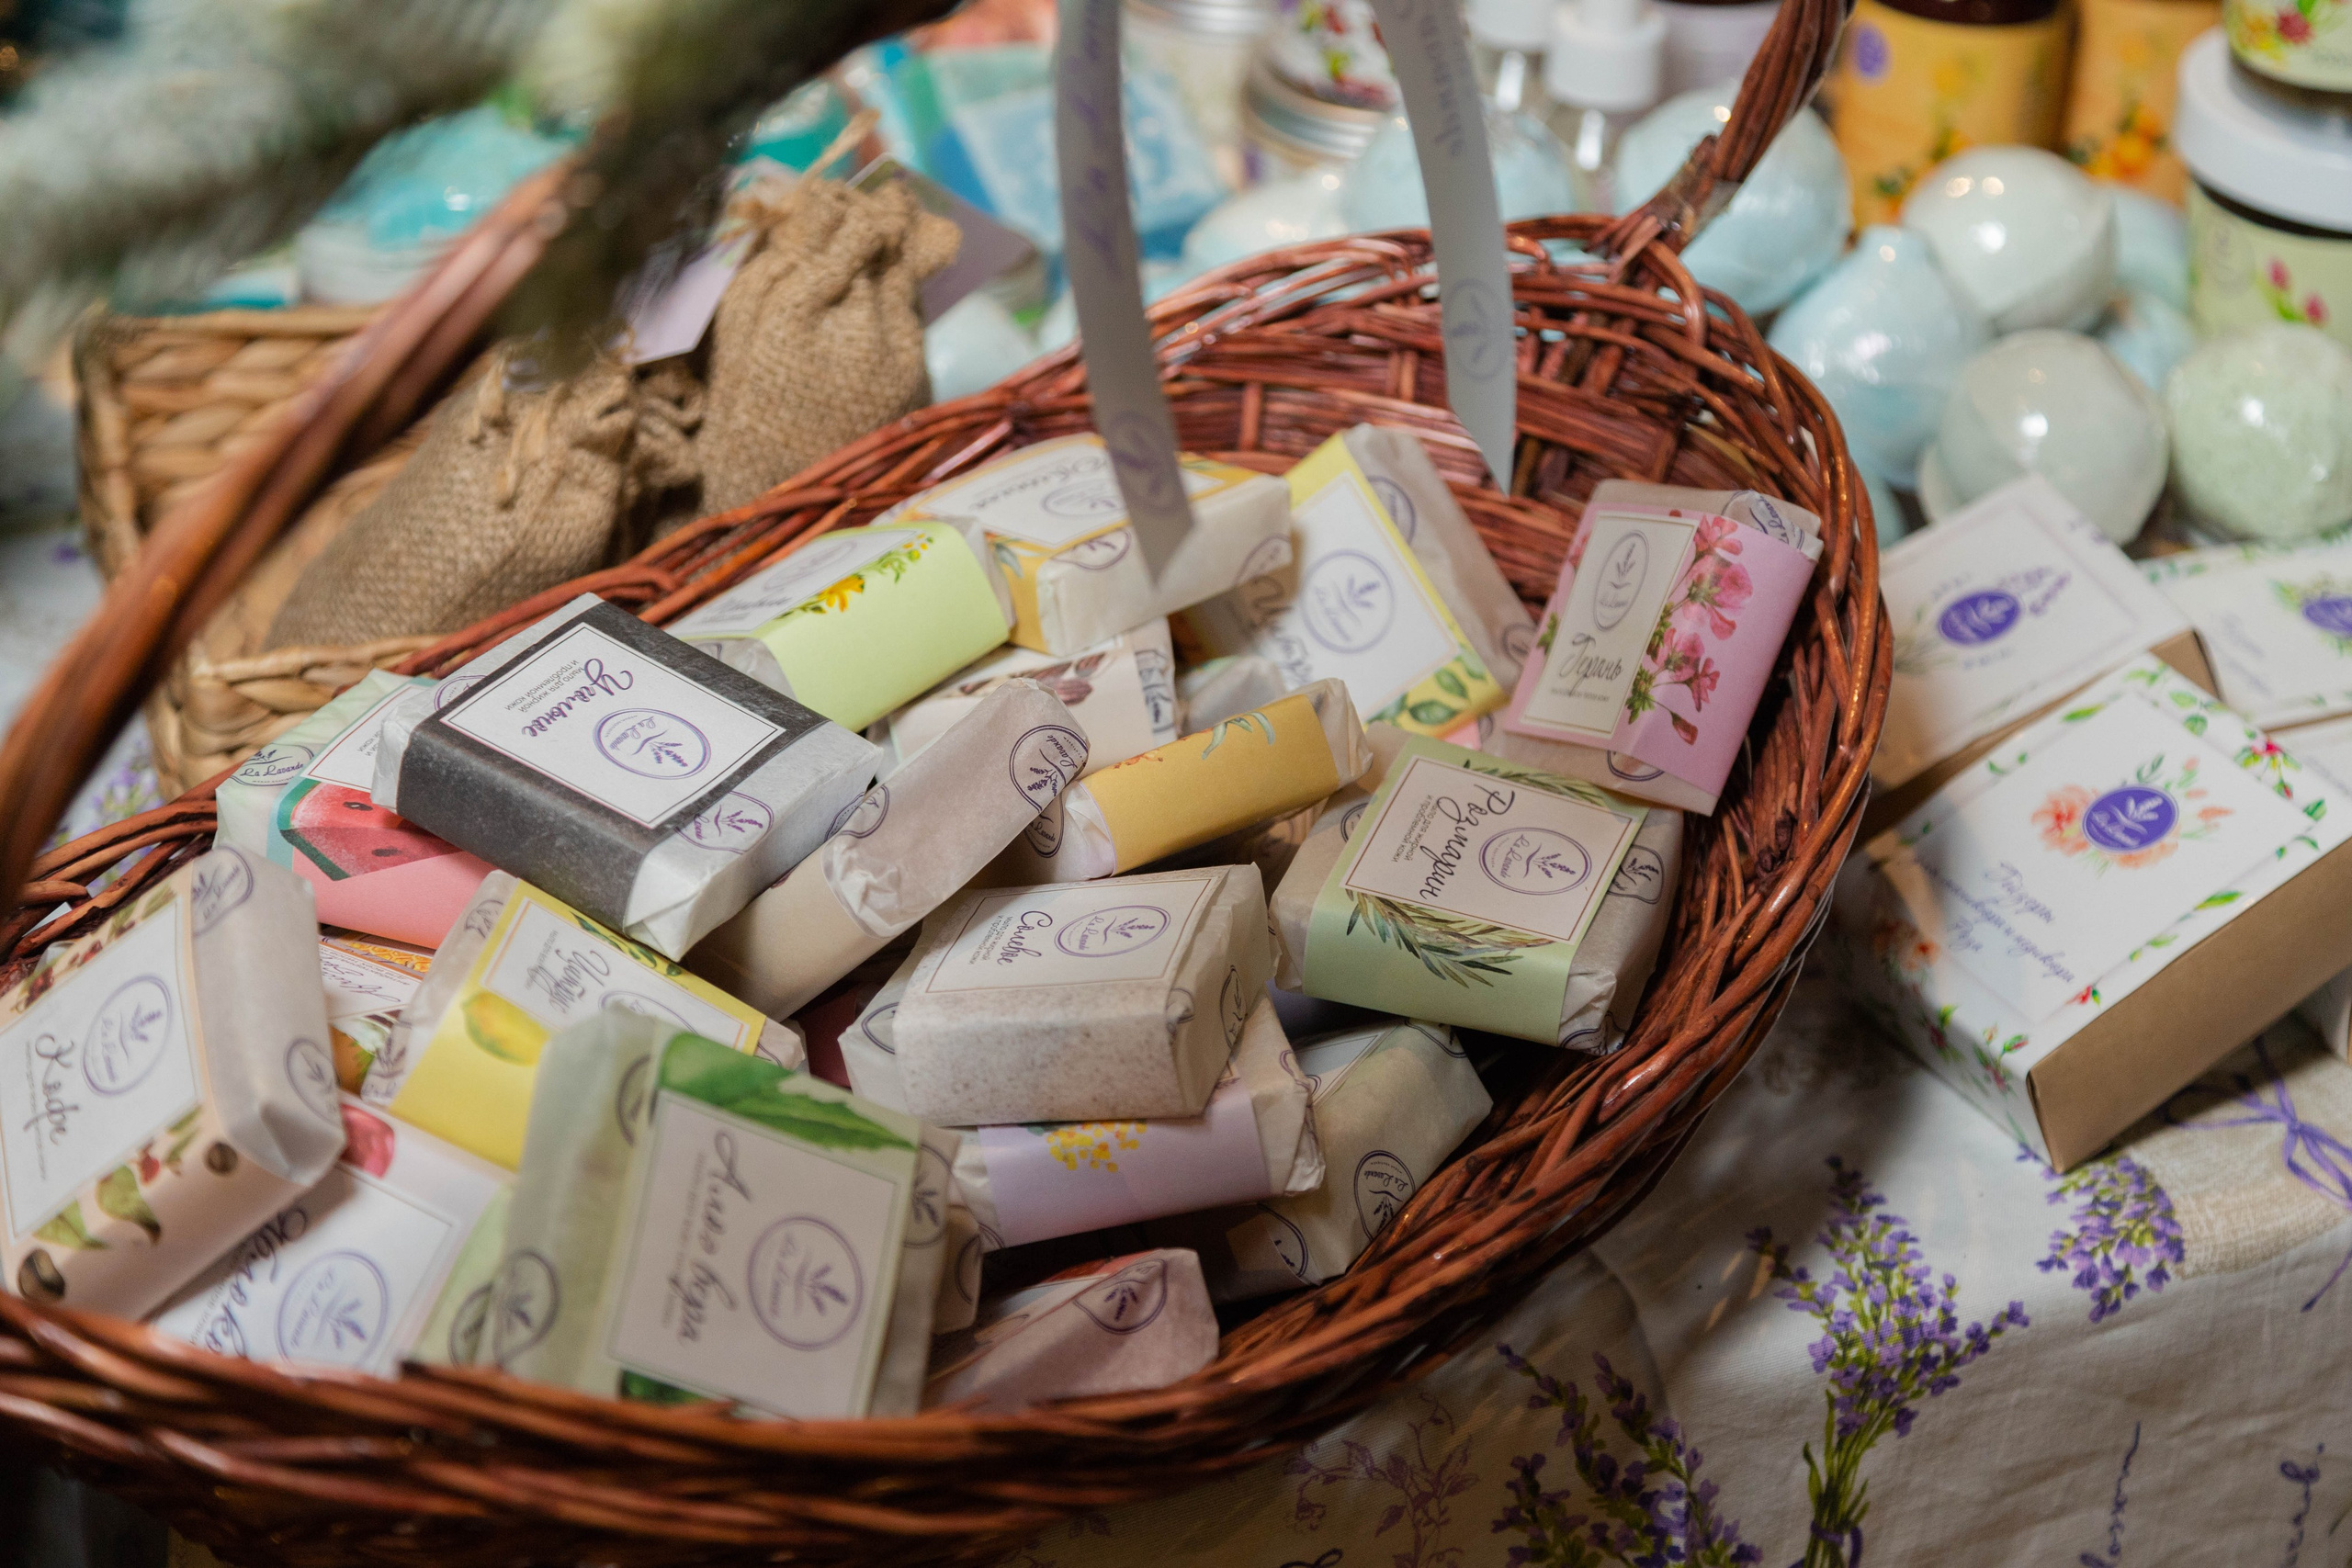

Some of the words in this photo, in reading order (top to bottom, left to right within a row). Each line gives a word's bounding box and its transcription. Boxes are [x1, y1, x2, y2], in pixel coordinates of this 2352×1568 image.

[525, 664, 572, 698] проблемной
[548, 678, 564, 693] для
[504, 696, 526, 711] кожи
[518, 691, 548, 713] жирной
[521, 658, 634, 737] Угольное
[1046, 734, 1079, 769] Lavande
[240, 768, 260, 777] La
[263, 761, 304, 777] Lavande
[1402, 801, 1430, 844] проблемной
[1392, 844, 1405, 863] кожи
[1404, 833, 1422, 861] жирной
[1419, 784, 1516, 900] Розмарин
[997, 910, 1053, 964] Солевое
[526, 949, 610, 1014] Цитрус
[23, 1033, 80, 1145] Кофе
[1363, 1170, 1394, 1187] Lavande
[1395, 1177, 1408, 1192] La
